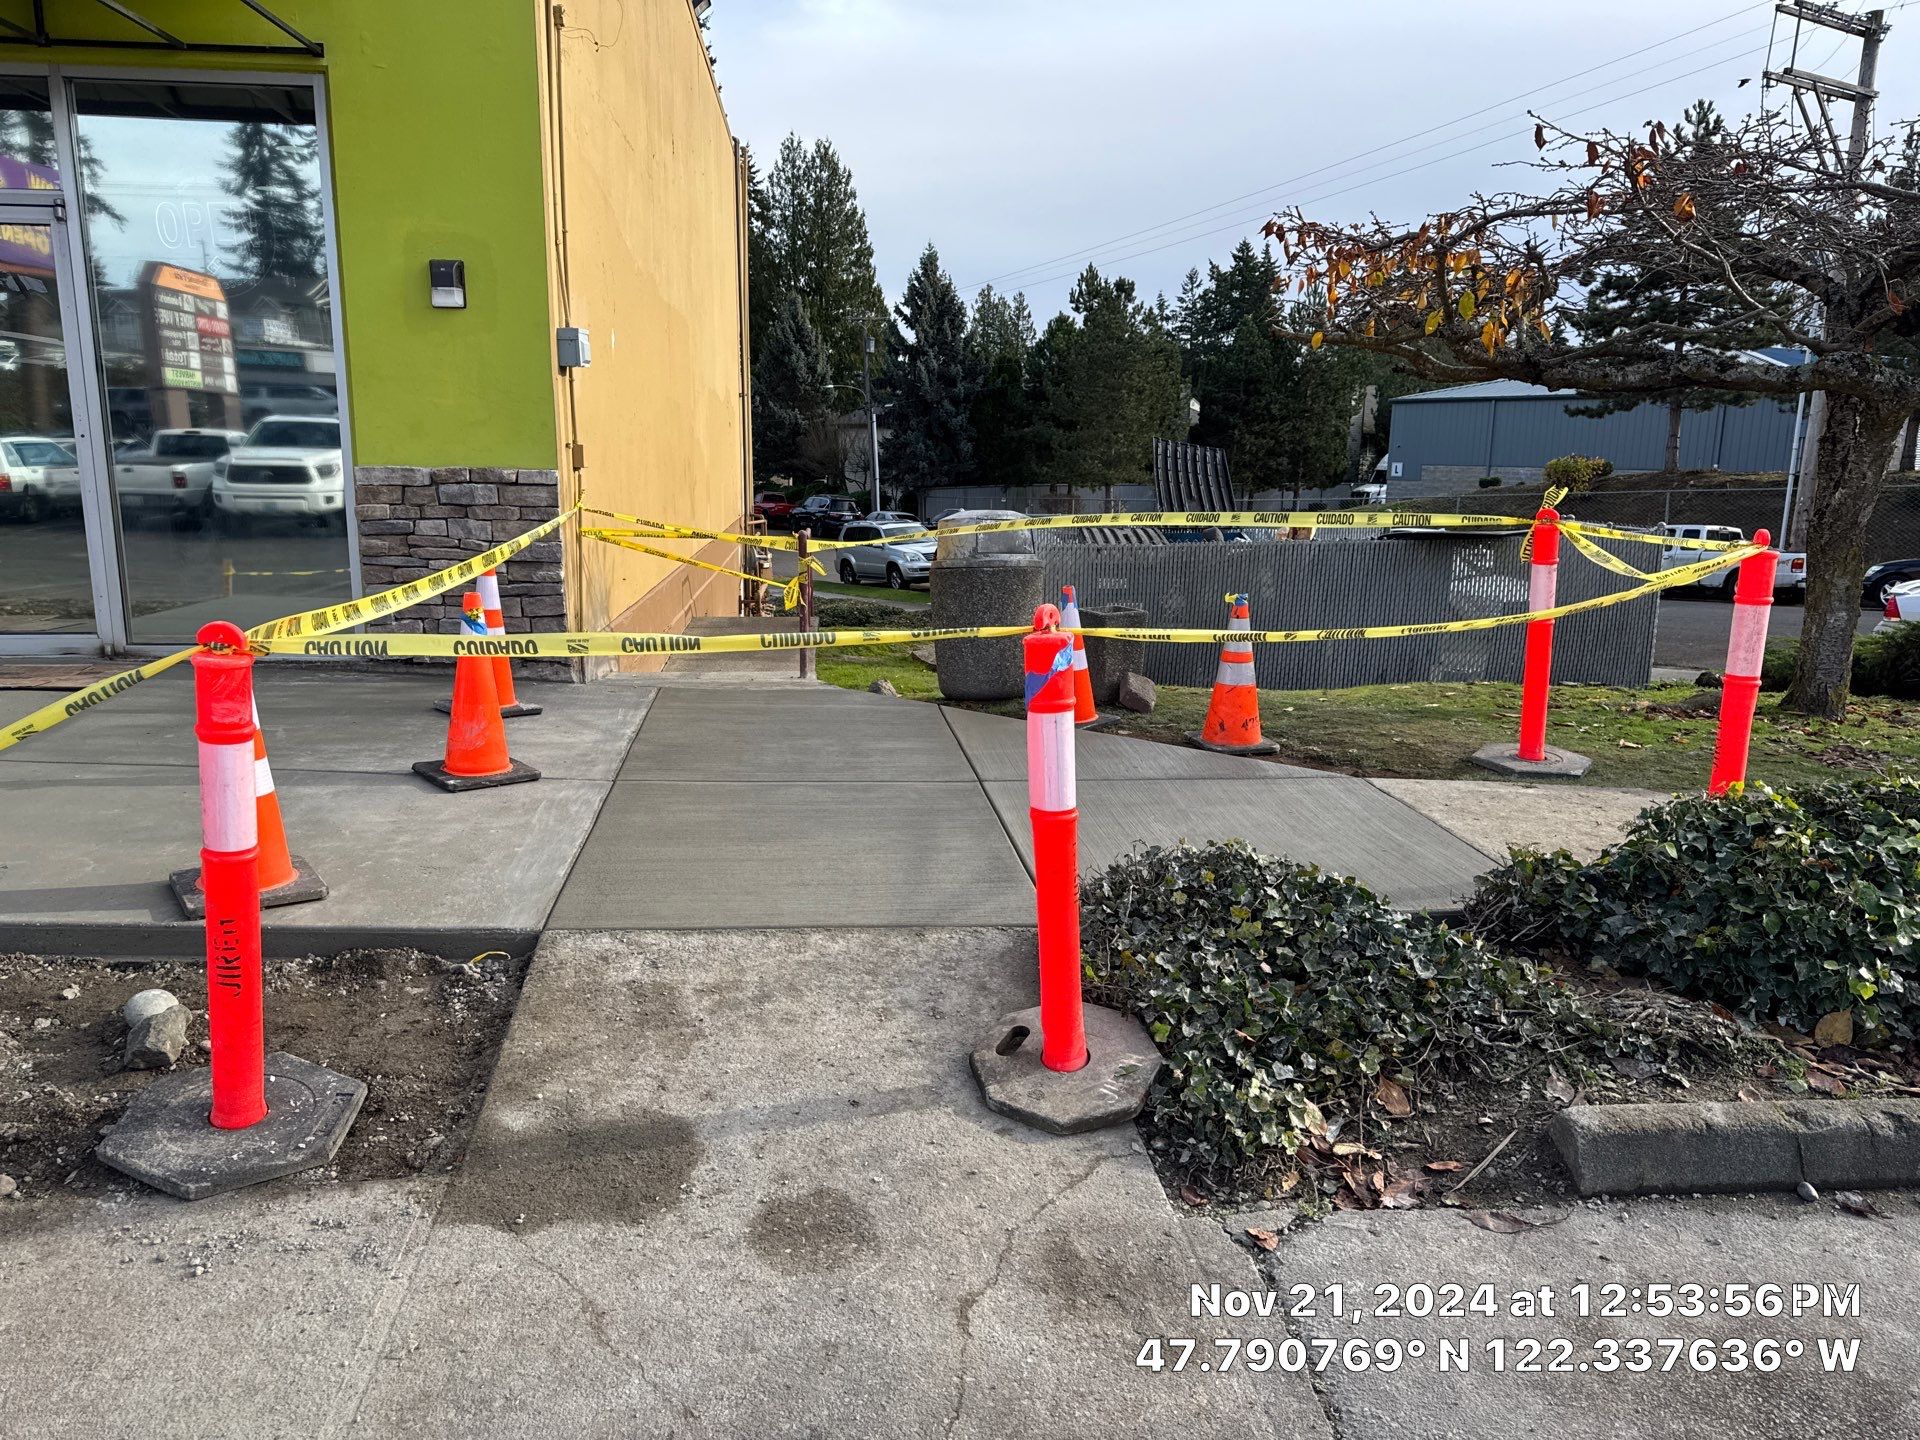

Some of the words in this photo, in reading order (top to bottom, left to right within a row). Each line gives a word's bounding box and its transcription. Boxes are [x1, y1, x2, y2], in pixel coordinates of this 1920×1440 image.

[1024, 517, 1052, 527] CAUTION
[1071, 514, 1102, 524] CUIDADO
[1130, 512, 1164, 523] CAUTION
[1186, 512, 1220, 523] CUIDADO
[1253, 512, 1290, 524] CAUTION
[1316, 513, 1355, 526] CUIDADO
[1392, 513, 1432, 527] CAUTION
